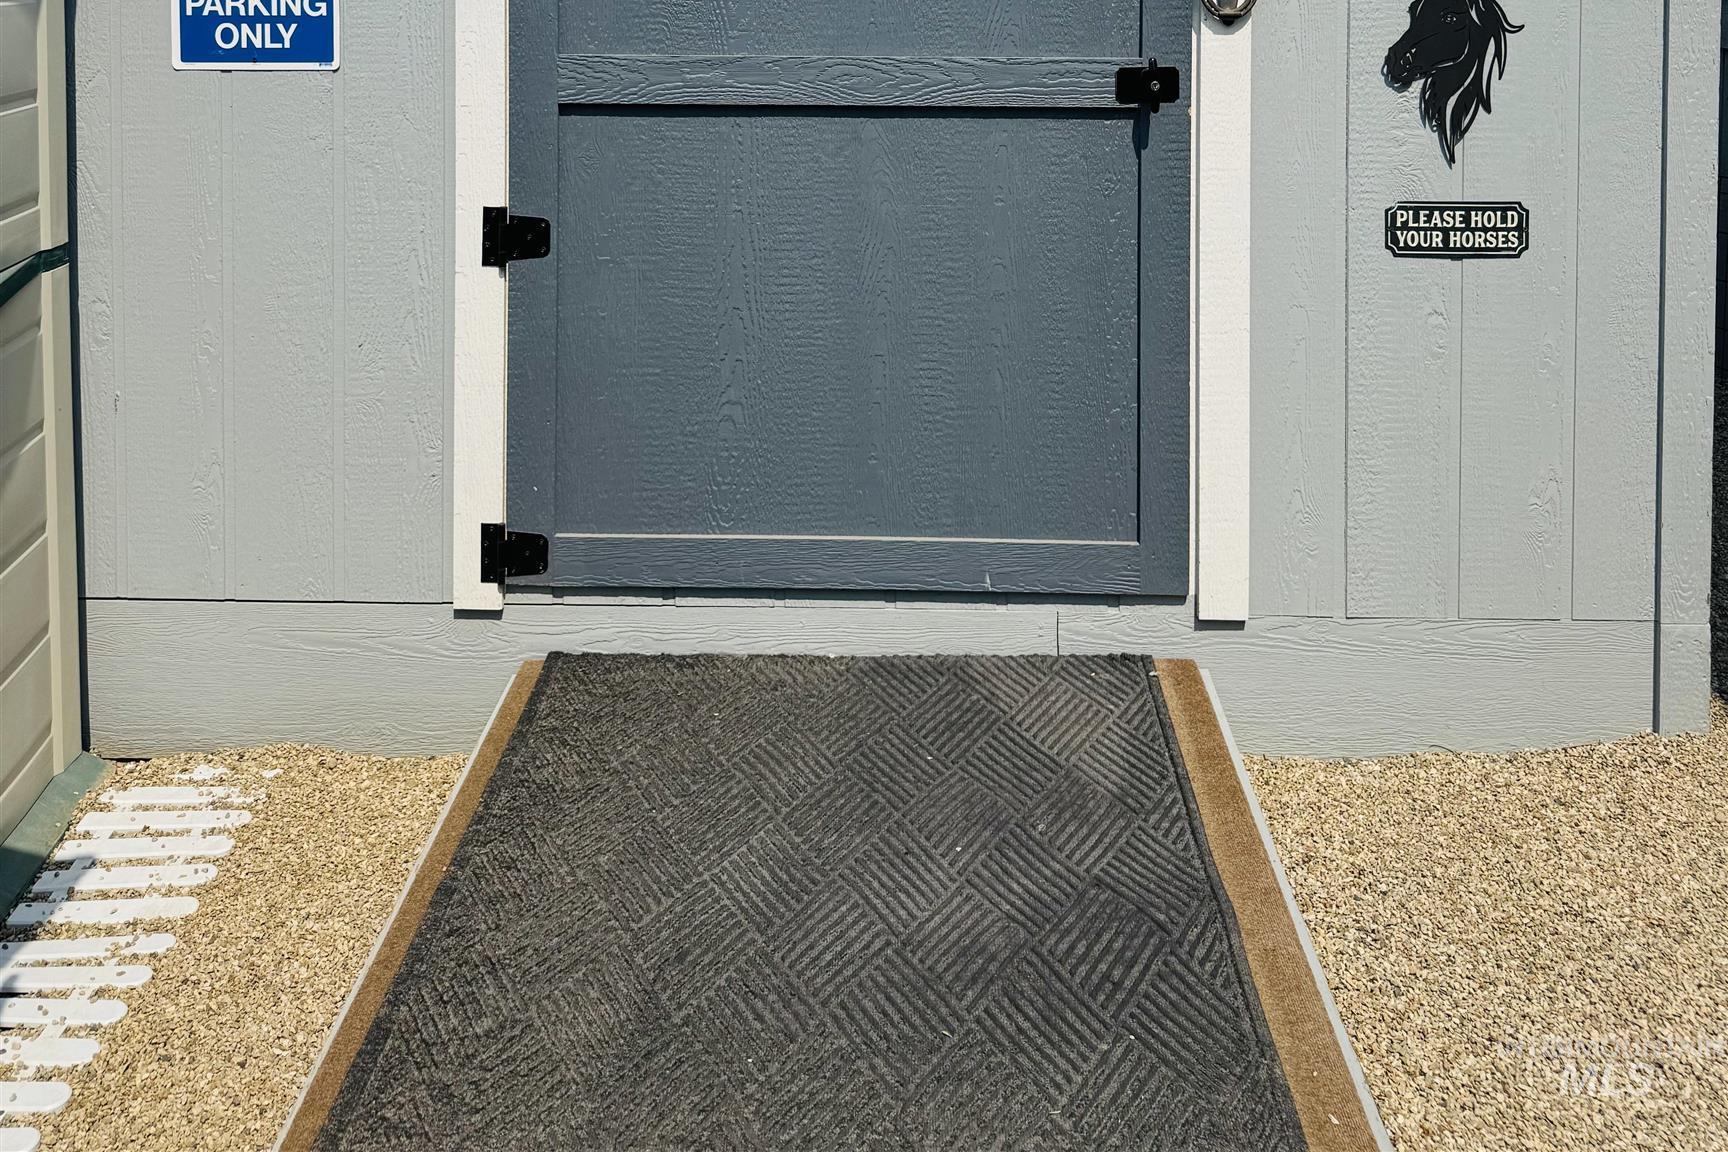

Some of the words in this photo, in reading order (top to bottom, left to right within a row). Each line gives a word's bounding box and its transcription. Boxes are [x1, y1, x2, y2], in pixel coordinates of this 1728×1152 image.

[214, 22, 298, 50] ONLY
[1396, 210, 1466, 228] PLEASE
[1470, 210, 1519, 228] HOLD
[1396, 230, 1444, 248] YOUR
[1449, 231, 1519, 248] HORSES
